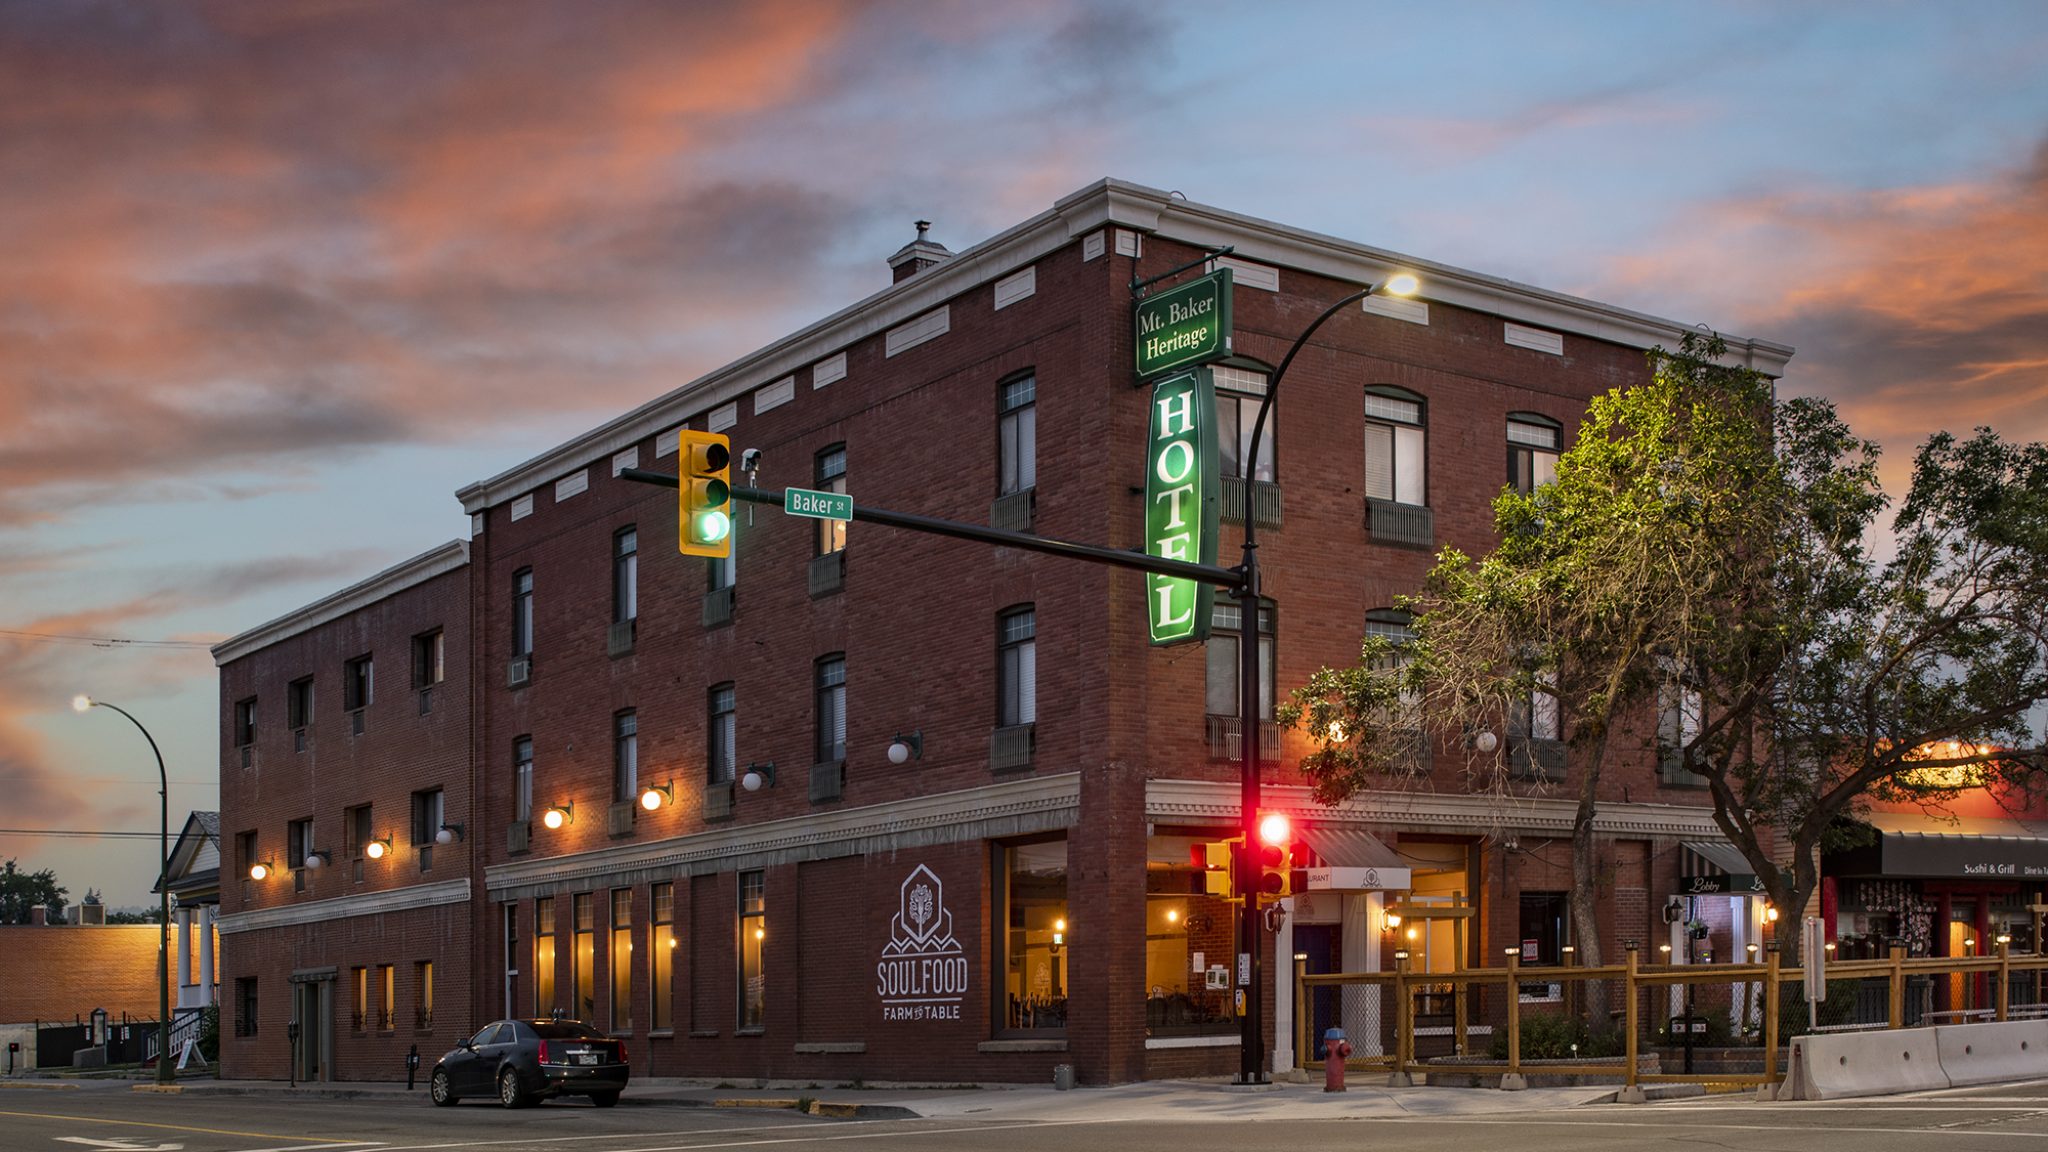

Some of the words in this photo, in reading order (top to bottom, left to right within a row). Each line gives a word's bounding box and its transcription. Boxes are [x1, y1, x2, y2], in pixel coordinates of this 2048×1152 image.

[1140, 311, 1165, 336] Mt.
[1169, 297, 1214, 325] Baker
[1146, 327, 1207, 361] Heritage
[793, 493, 833, 514] Baker
[836, 501, 844, 511] St
[1156, 389, 1195, 628] HOTEL
[1964, 863, 1987, 874] Sushi
[1989, 863, 1996, 874] &
[1997, 863, 2015, 875] Grill
[2024, 866, 2037, 875] Dine
[1689, 877, 1720, 893] Lobby
[877, 957, 968, 996] SOULFOOD
[884, 1007, 913, 1020] FARM
[924, 1005, 960, 1019] TABLE
